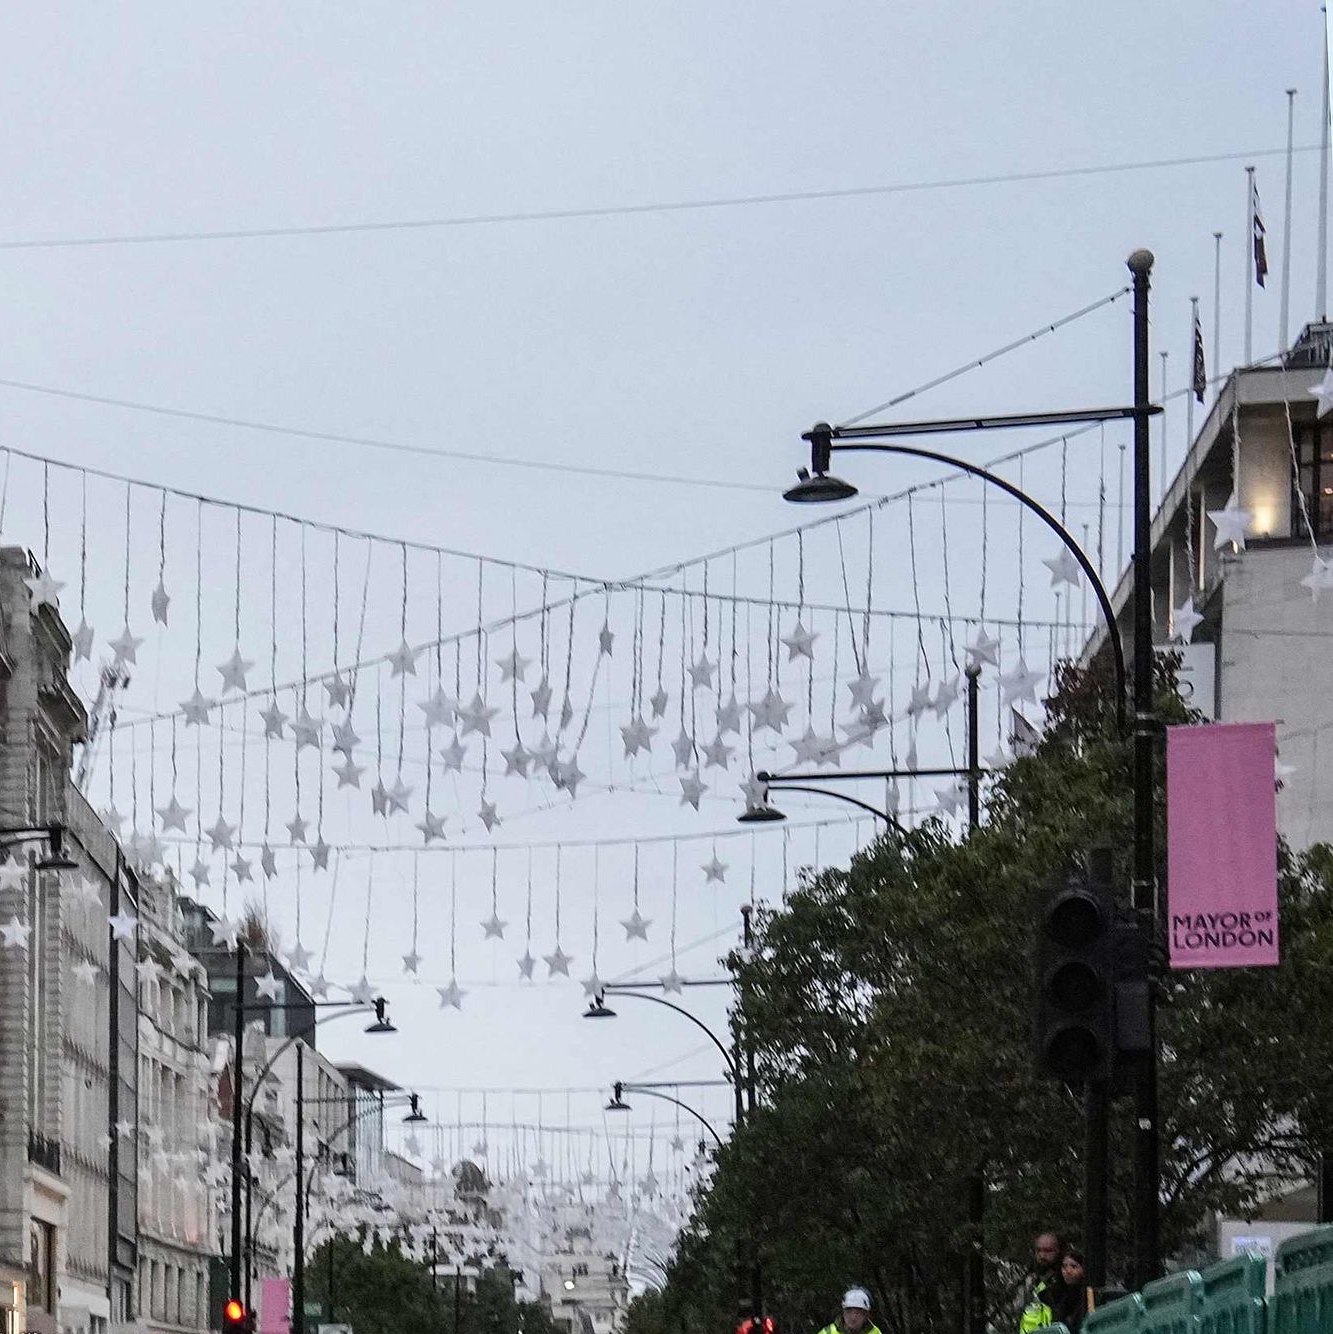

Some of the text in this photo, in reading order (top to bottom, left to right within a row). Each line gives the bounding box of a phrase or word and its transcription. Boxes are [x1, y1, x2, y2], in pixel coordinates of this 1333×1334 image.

[1173, 910, 1273, 931] MAYOR OF
[1173, 929, 1274, 949] LONDON
